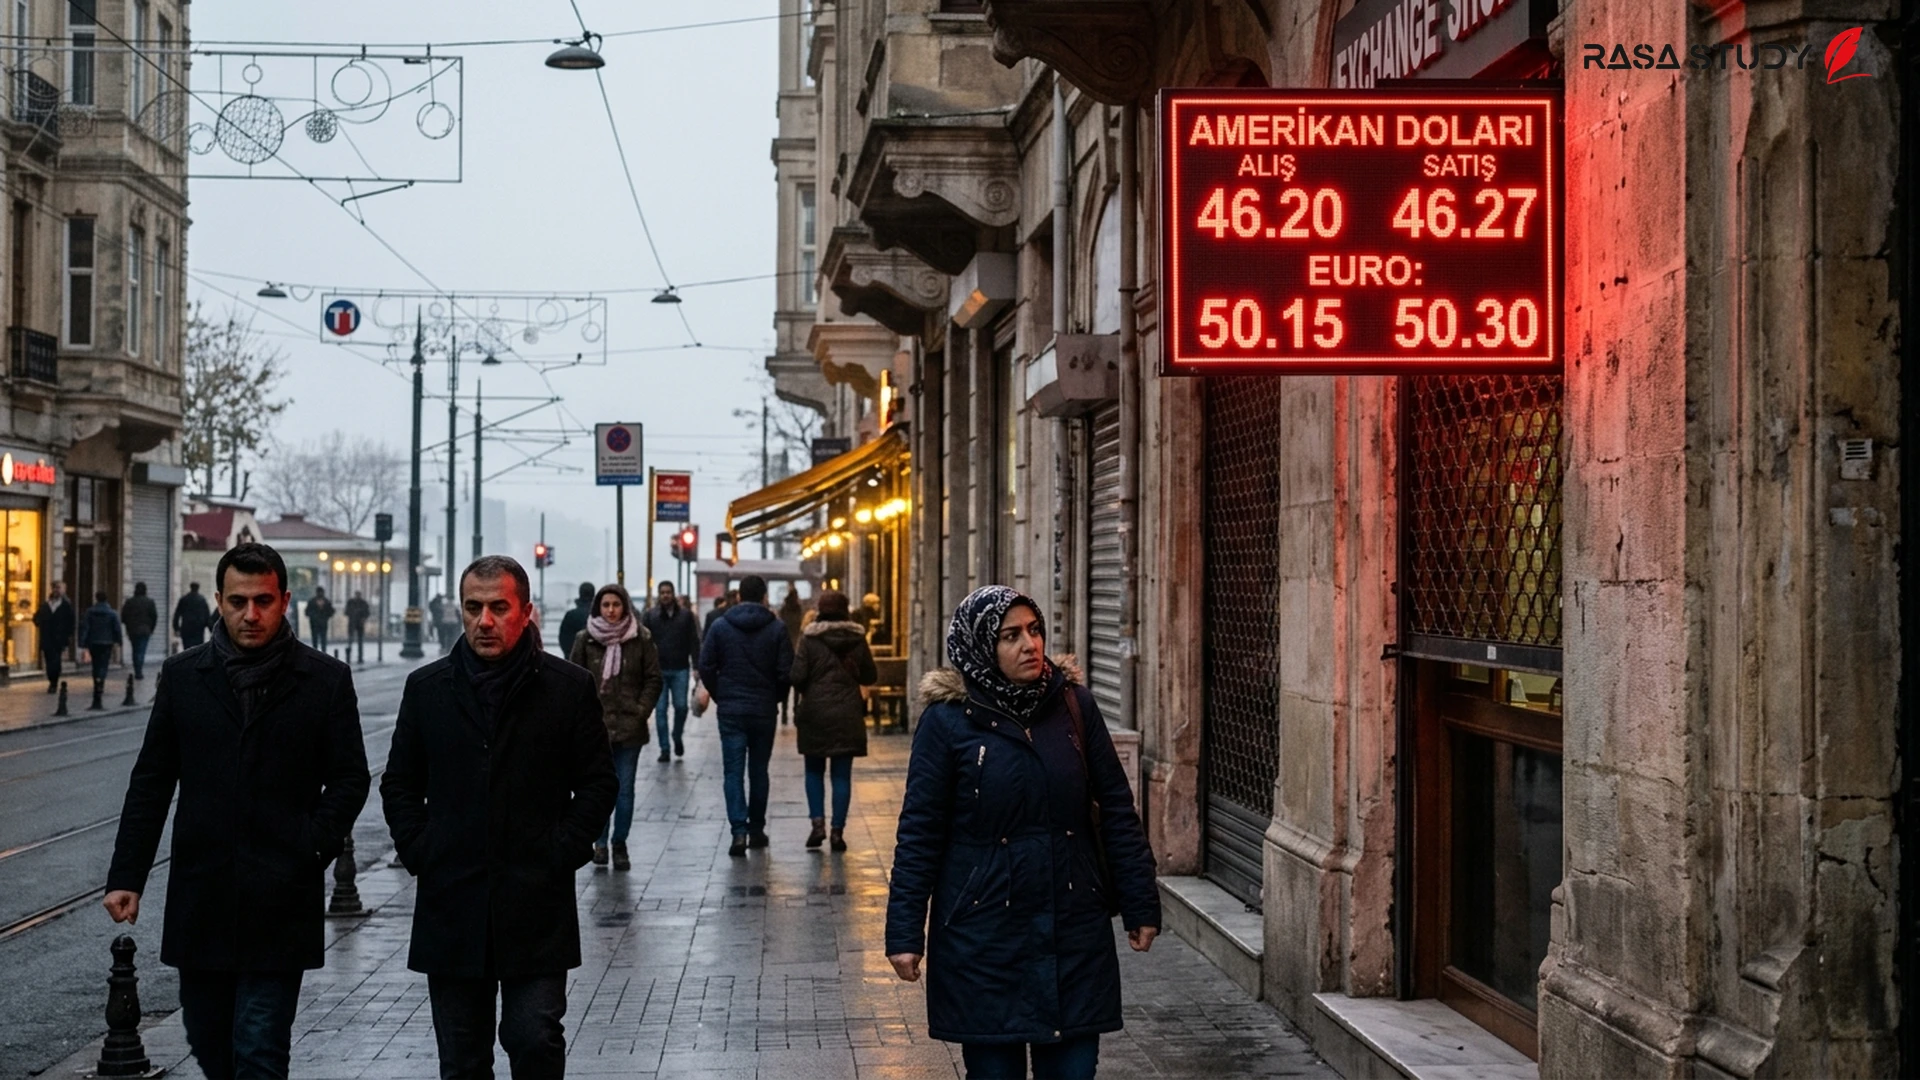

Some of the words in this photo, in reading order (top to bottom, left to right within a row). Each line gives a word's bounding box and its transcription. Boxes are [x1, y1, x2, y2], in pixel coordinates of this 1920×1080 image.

[1189, 107, 1384, 146] AMERİKAN
[1396, 114, 1533, 146] DOLARI
[1237, 153, 1297, 182] ALIŞ
[1423, 153, 1497, 182] SATIŞ
[1197, 188, 1343, 238] 46.20
[1392, 188, 1537, 238] 46.27
[1308, 255, 1424, 286] EURO:
[329, 307, 356, 330] T1
[1198, 298, 1343, 348] 50.15
[1394, 298, 1539, 348] 50.30
